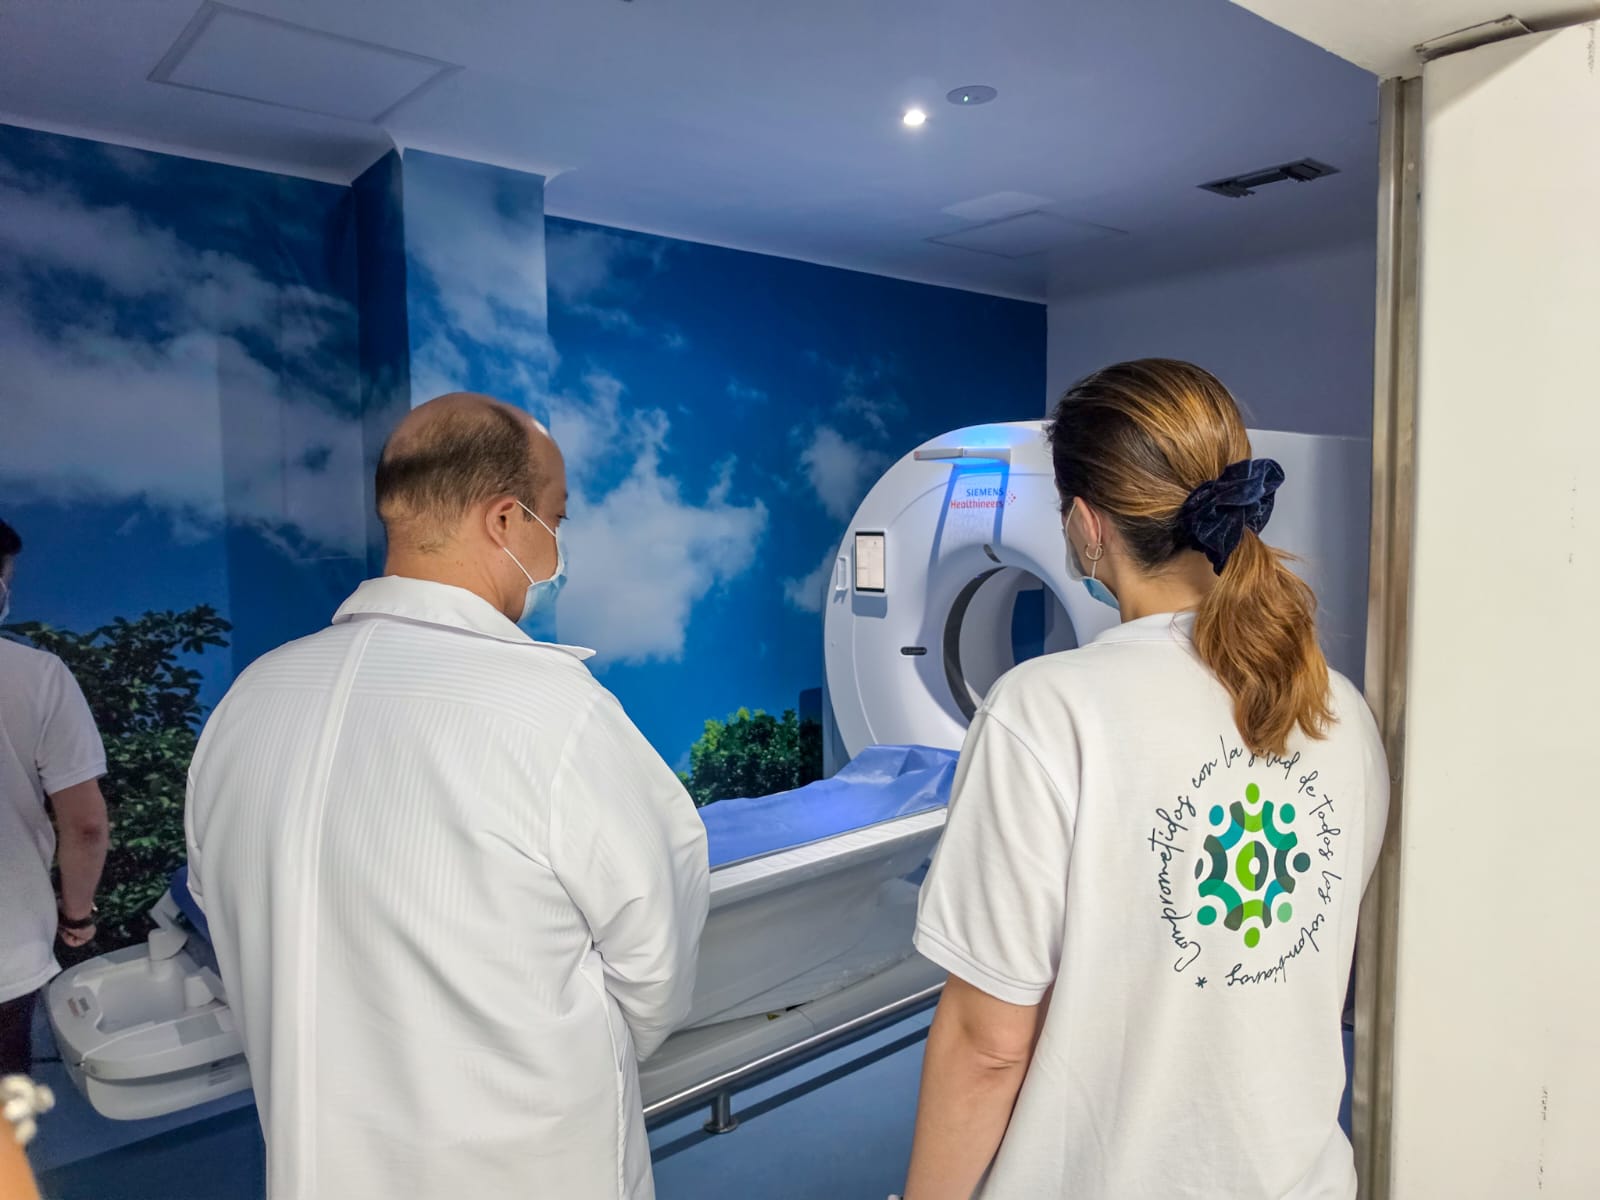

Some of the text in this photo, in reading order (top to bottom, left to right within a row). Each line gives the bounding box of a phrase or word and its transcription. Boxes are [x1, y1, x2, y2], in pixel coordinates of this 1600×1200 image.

[966, 487, 1004, 497] SIEMENS
[950, 499, 1004, 509] Healthineers
[1192, 759, 1218, 788] con
[1219, 734, 1243, 768] la
[1298, 770, 1319, 797] de
[1318, 870, 1342, 905] los
